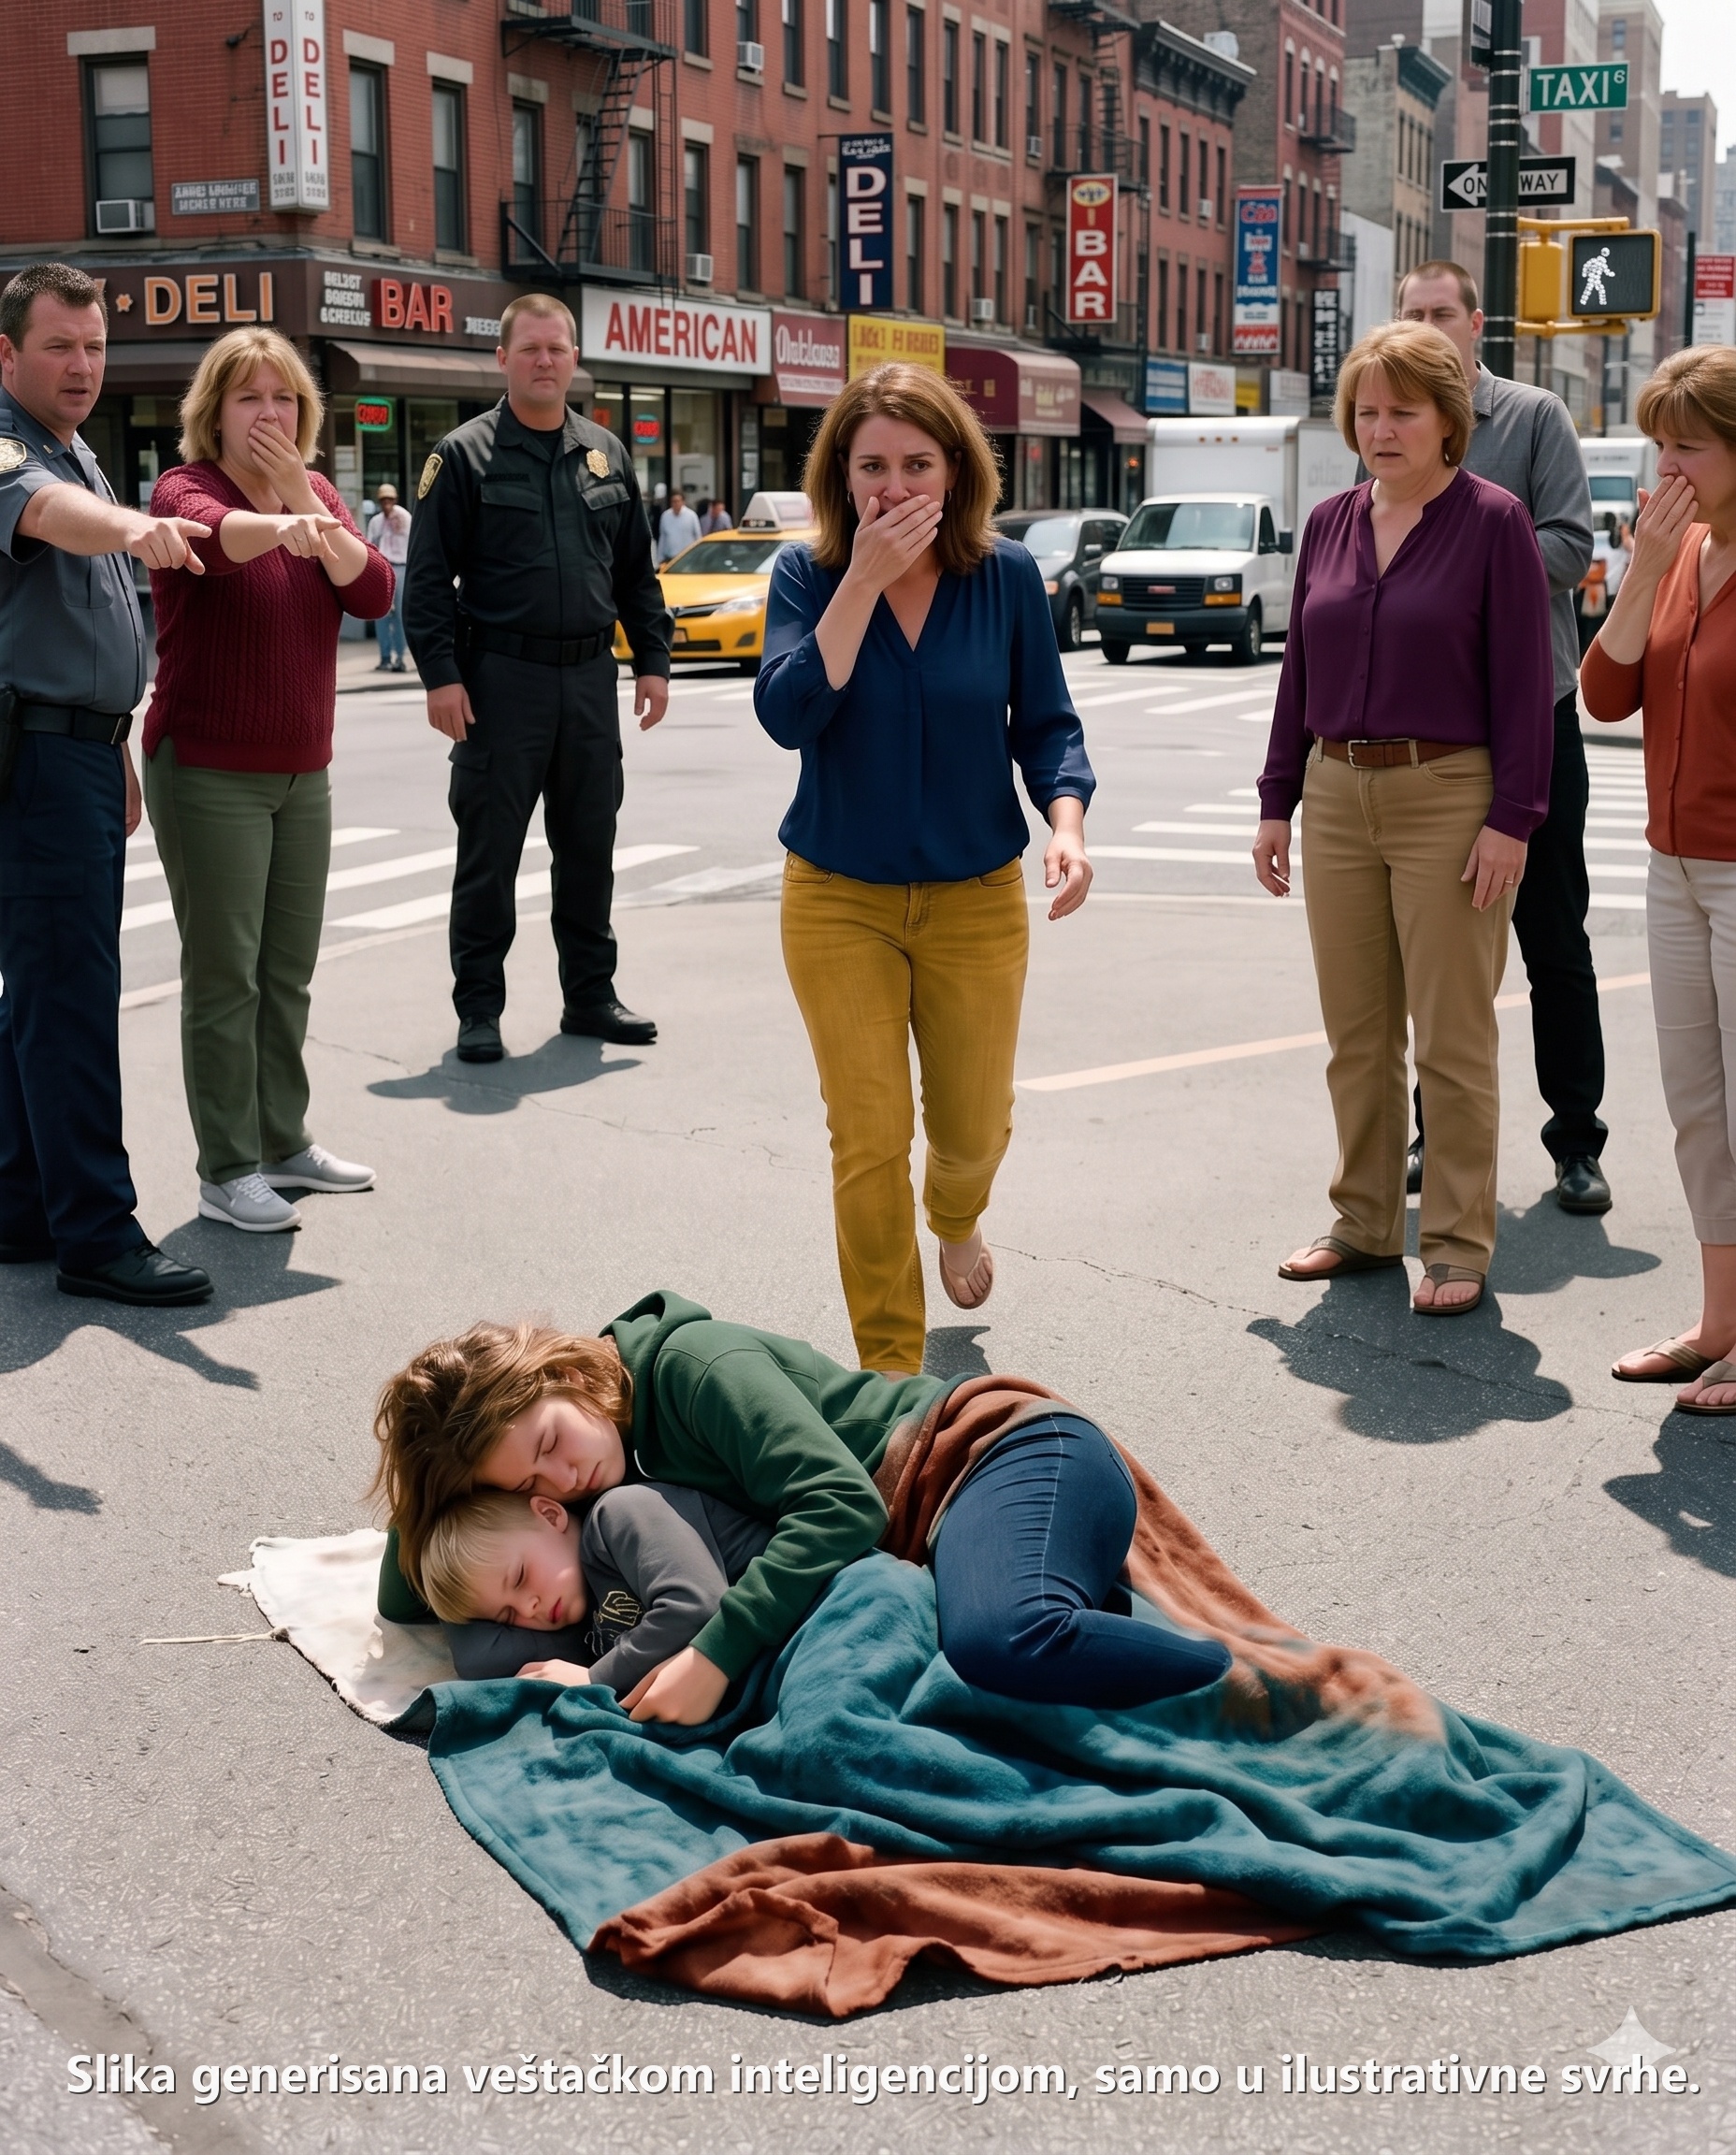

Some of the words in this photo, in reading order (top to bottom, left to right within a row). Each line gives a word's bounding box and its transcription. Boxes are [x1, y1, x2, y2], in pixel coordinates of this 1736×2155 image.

[270, 38, 289, 165] DELI
[303, 37, 321, 165] DELI
[1537, 70, 1609, 107] TAXI
[1464, 176, 1488, 195] ON
[1520, 173, 1559, 193] WAY
[846, 166, 887, 306] DELI
[144, 271, 274, 325] DELI
[1074, 228, 1108, 318] BAR
[380, 277, 455, 334] BAR
[604, 301, 758, 365] AMERICAN
